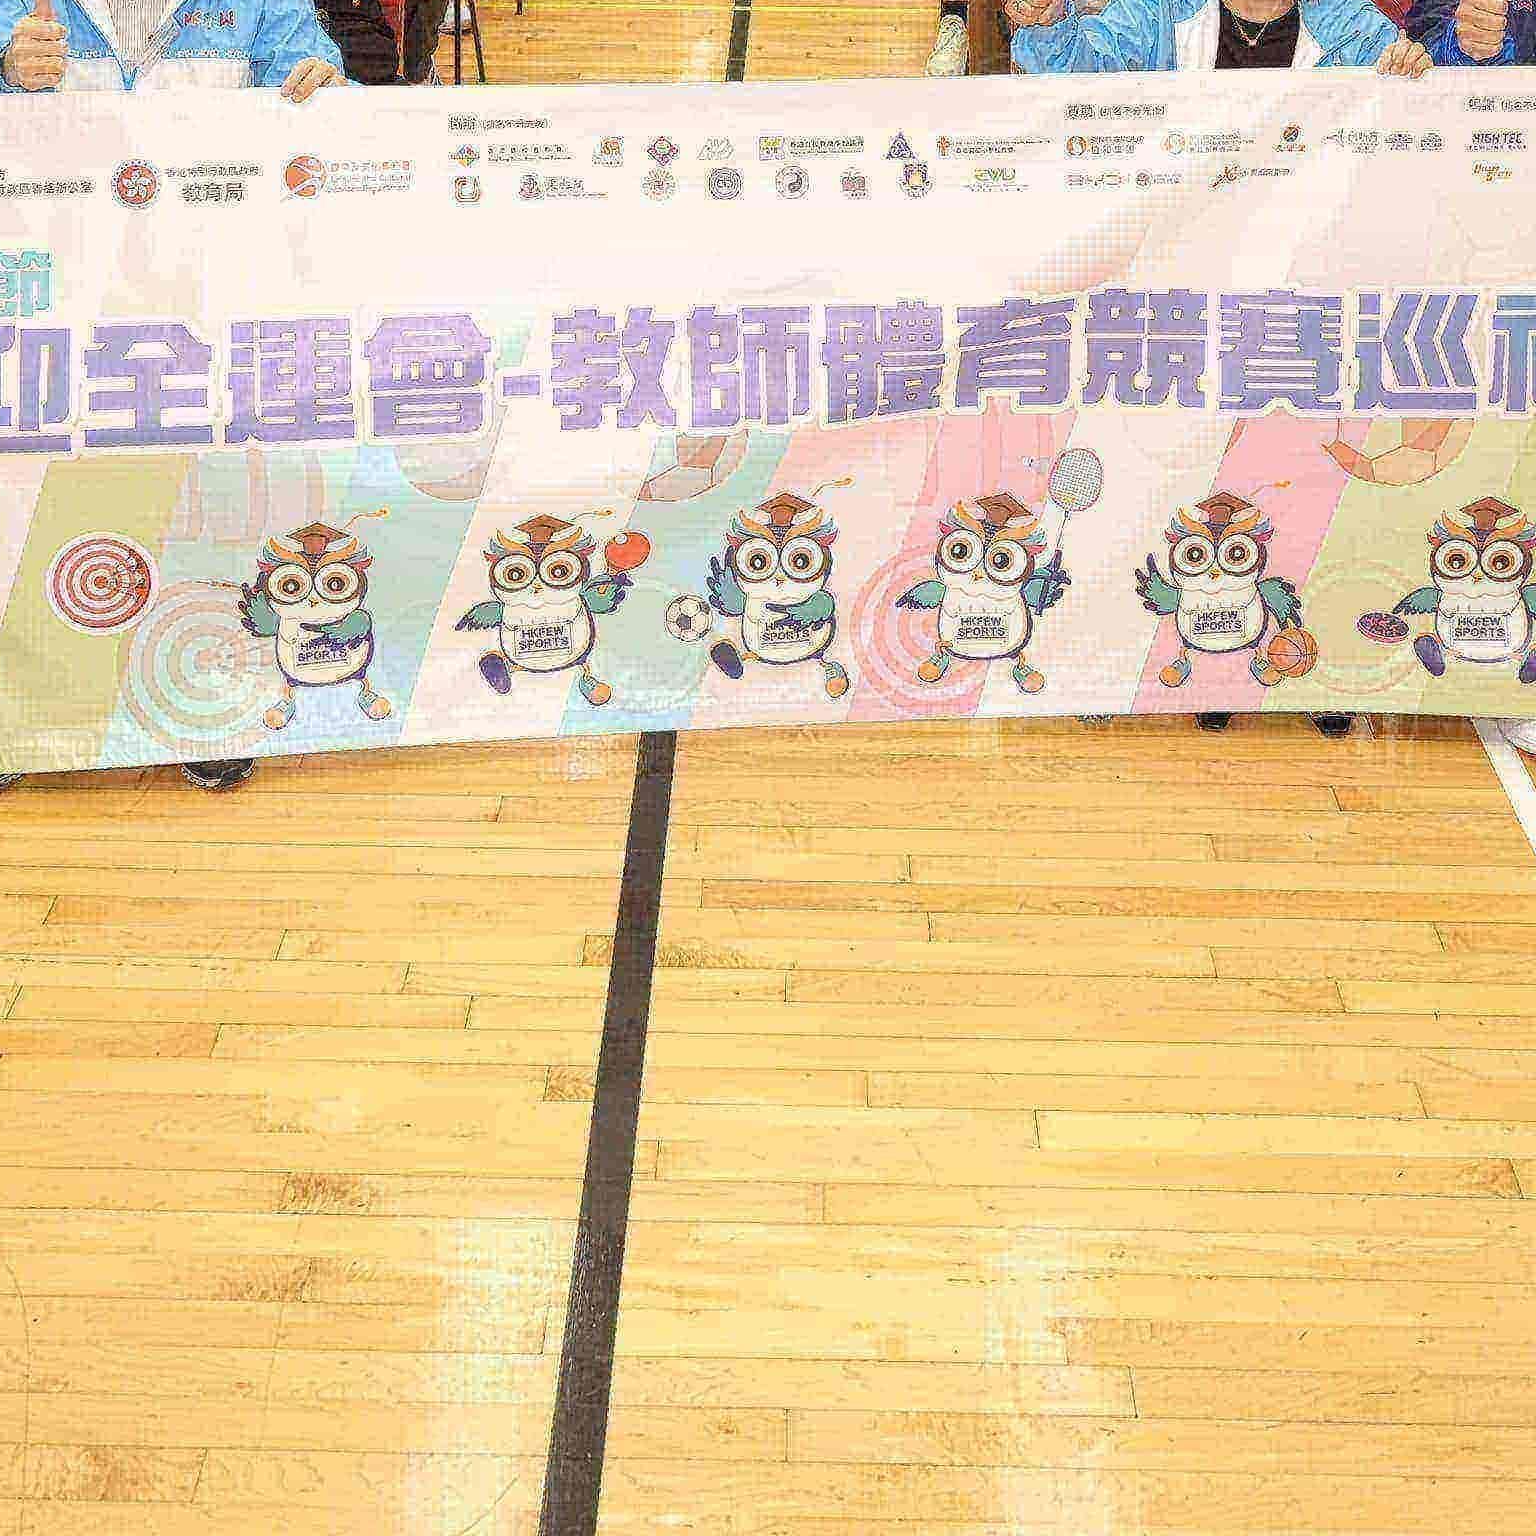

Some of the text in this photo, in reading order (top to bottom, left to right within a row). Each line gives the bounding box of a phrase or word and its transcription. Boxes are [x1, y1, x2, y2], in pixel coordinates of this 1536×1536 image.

[182, 182, 245, 203] 教育局
[960, 615, 1002, 627] HKFEW
[1196, 609, 1238, 622] HKFEW
[1457, 615, 1502, 627] HKFEW
[521, 624, 564, 639] HKFEW
[957, 625, 1006, 637] SPORTS
[1193, 619, 1243, 632] SPORTS
[1454, 626, 1506, 639] SPORTS
[518, 636, 570, 651] SPORTS
[297, 649, 348, 664] SPORTS
